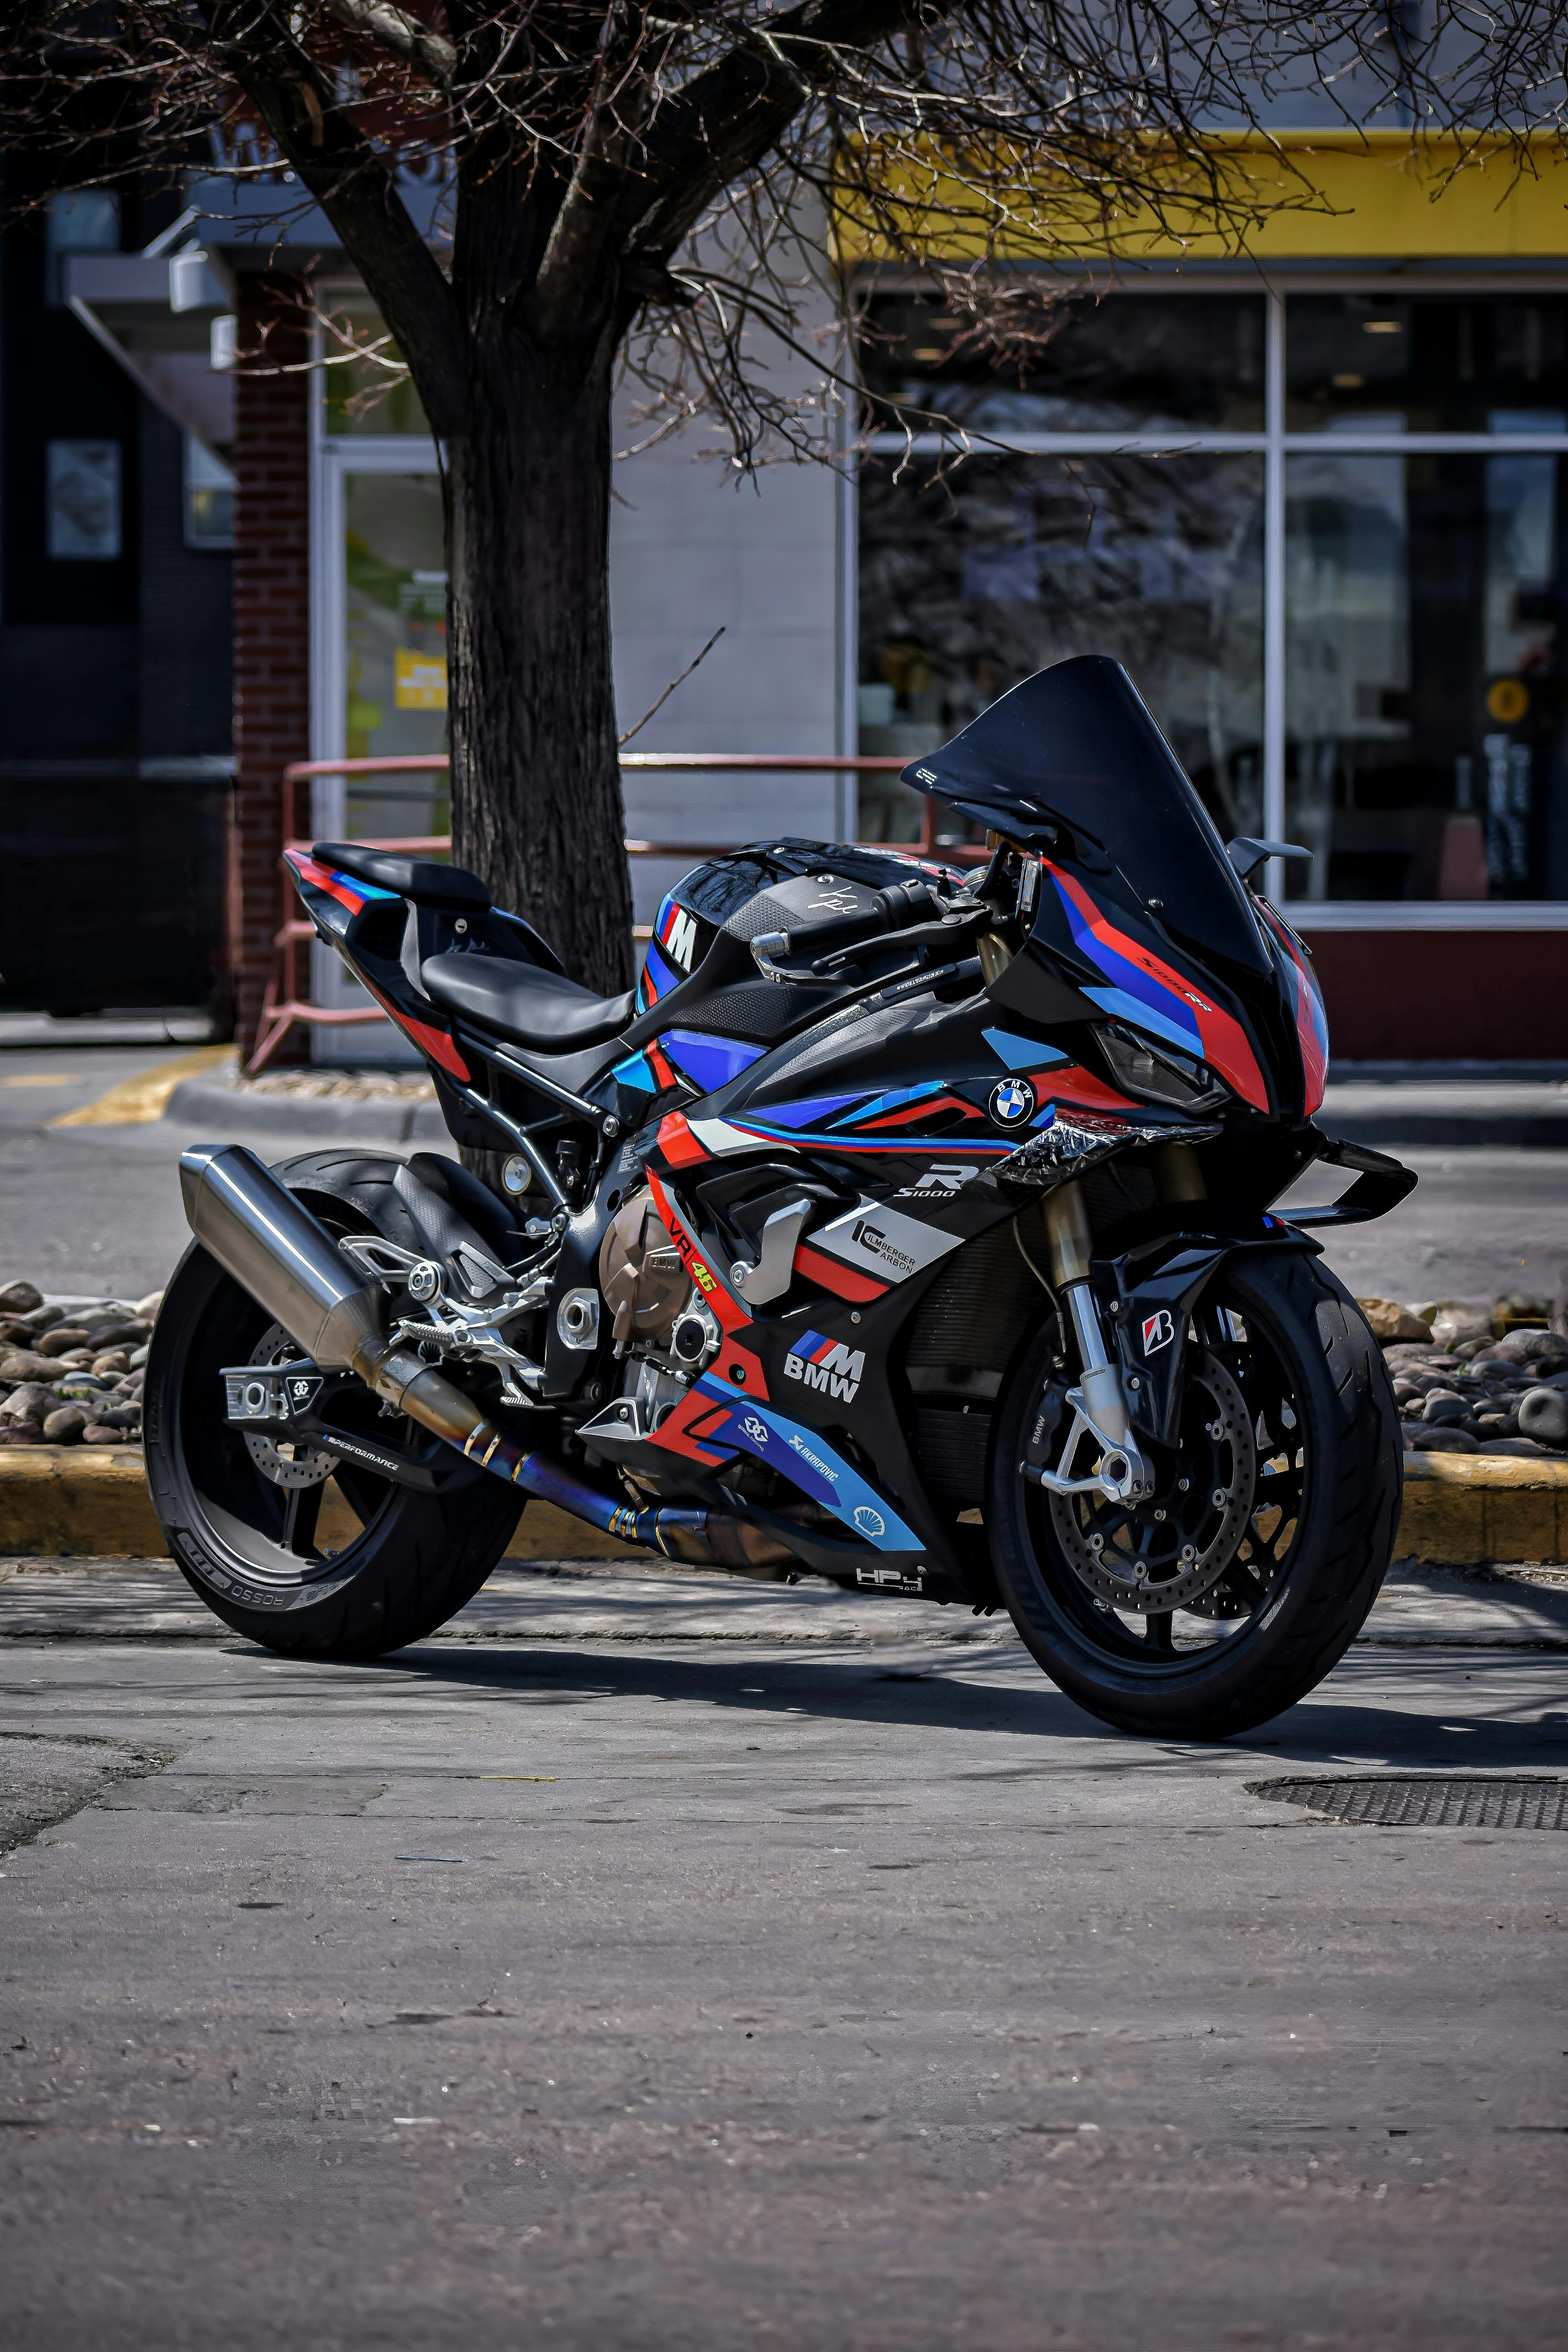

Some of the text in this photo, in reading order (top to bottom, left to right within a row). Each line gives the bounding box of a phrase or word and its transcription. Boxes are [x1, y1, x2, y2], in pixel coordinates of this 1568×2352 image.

[997, 1080, 1032, 1098] BMW
[893, 1188, 956, 1197] S1000
[652, 1258, 676, 1269] BMW
[783, 1353, 859, 1403] BMW
[1032, 1414, 1045, 1444] BMW
[231, 1585, 285, 1605] ROSSO
